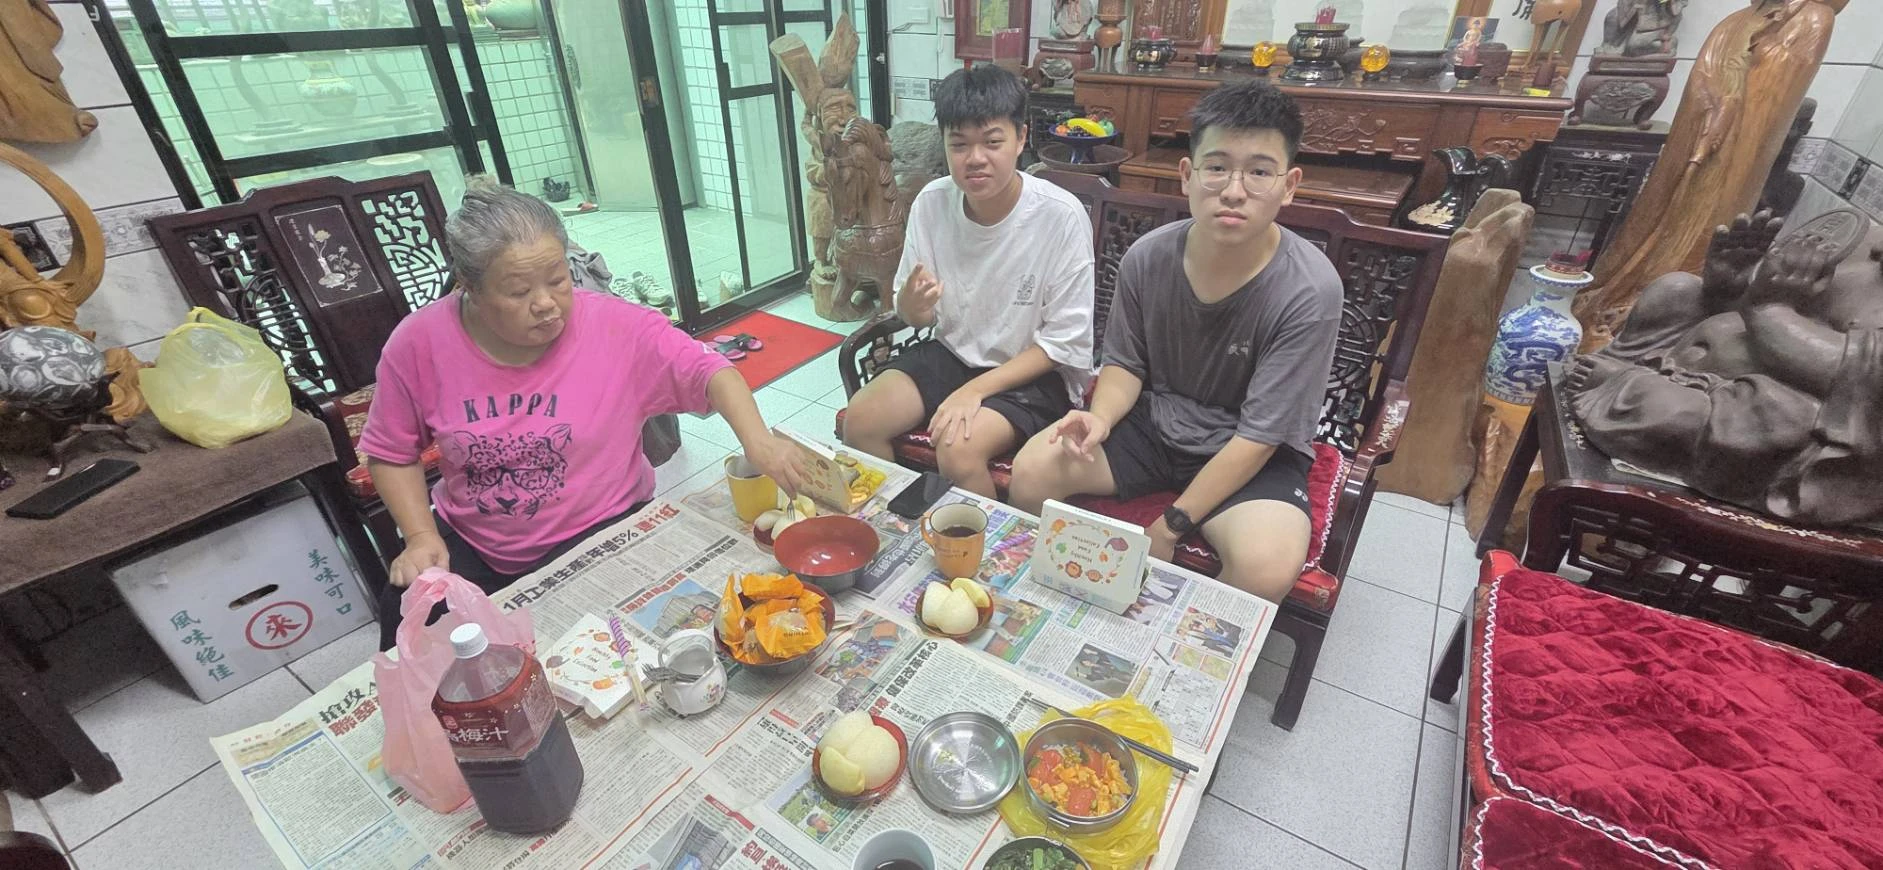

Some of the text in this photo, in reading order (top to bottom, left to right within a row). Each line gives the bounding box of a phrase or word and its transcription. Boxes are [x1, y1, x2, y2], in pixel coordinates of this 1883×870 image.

[463, 392, 559, 423] KAPPA
[306, 549, 353, 616] 美味可口
[265, 614, 303, 641] 來
[328, 696, 382, 737] 聯發
